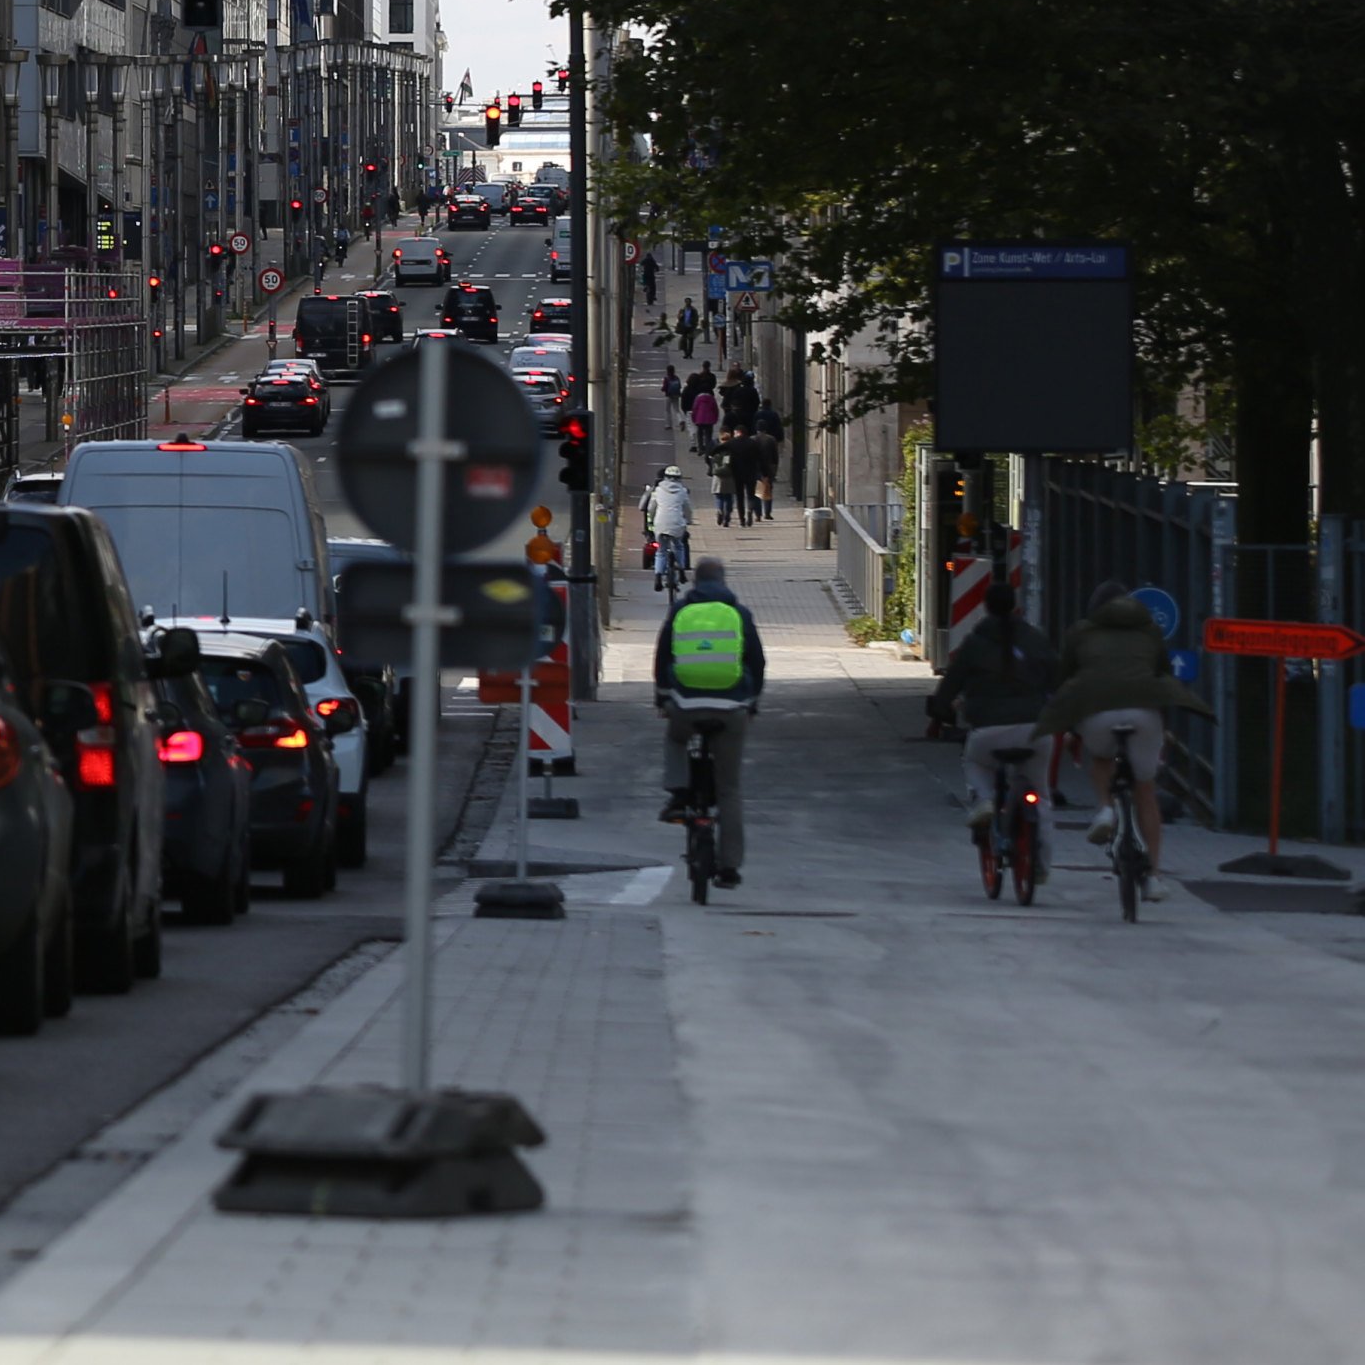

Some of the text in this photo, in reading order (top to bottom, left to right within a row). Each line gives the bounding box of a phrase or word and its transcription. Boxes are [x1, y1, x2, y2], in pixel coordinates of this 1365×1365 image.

[233, 238, 246, 247] 50
[943, 251, 961, 273] P
[972, 251, 996, 264] Zone
[998, 251, 1054, 264] Kunst-Wet
[264, 274, 278, 284] 50
